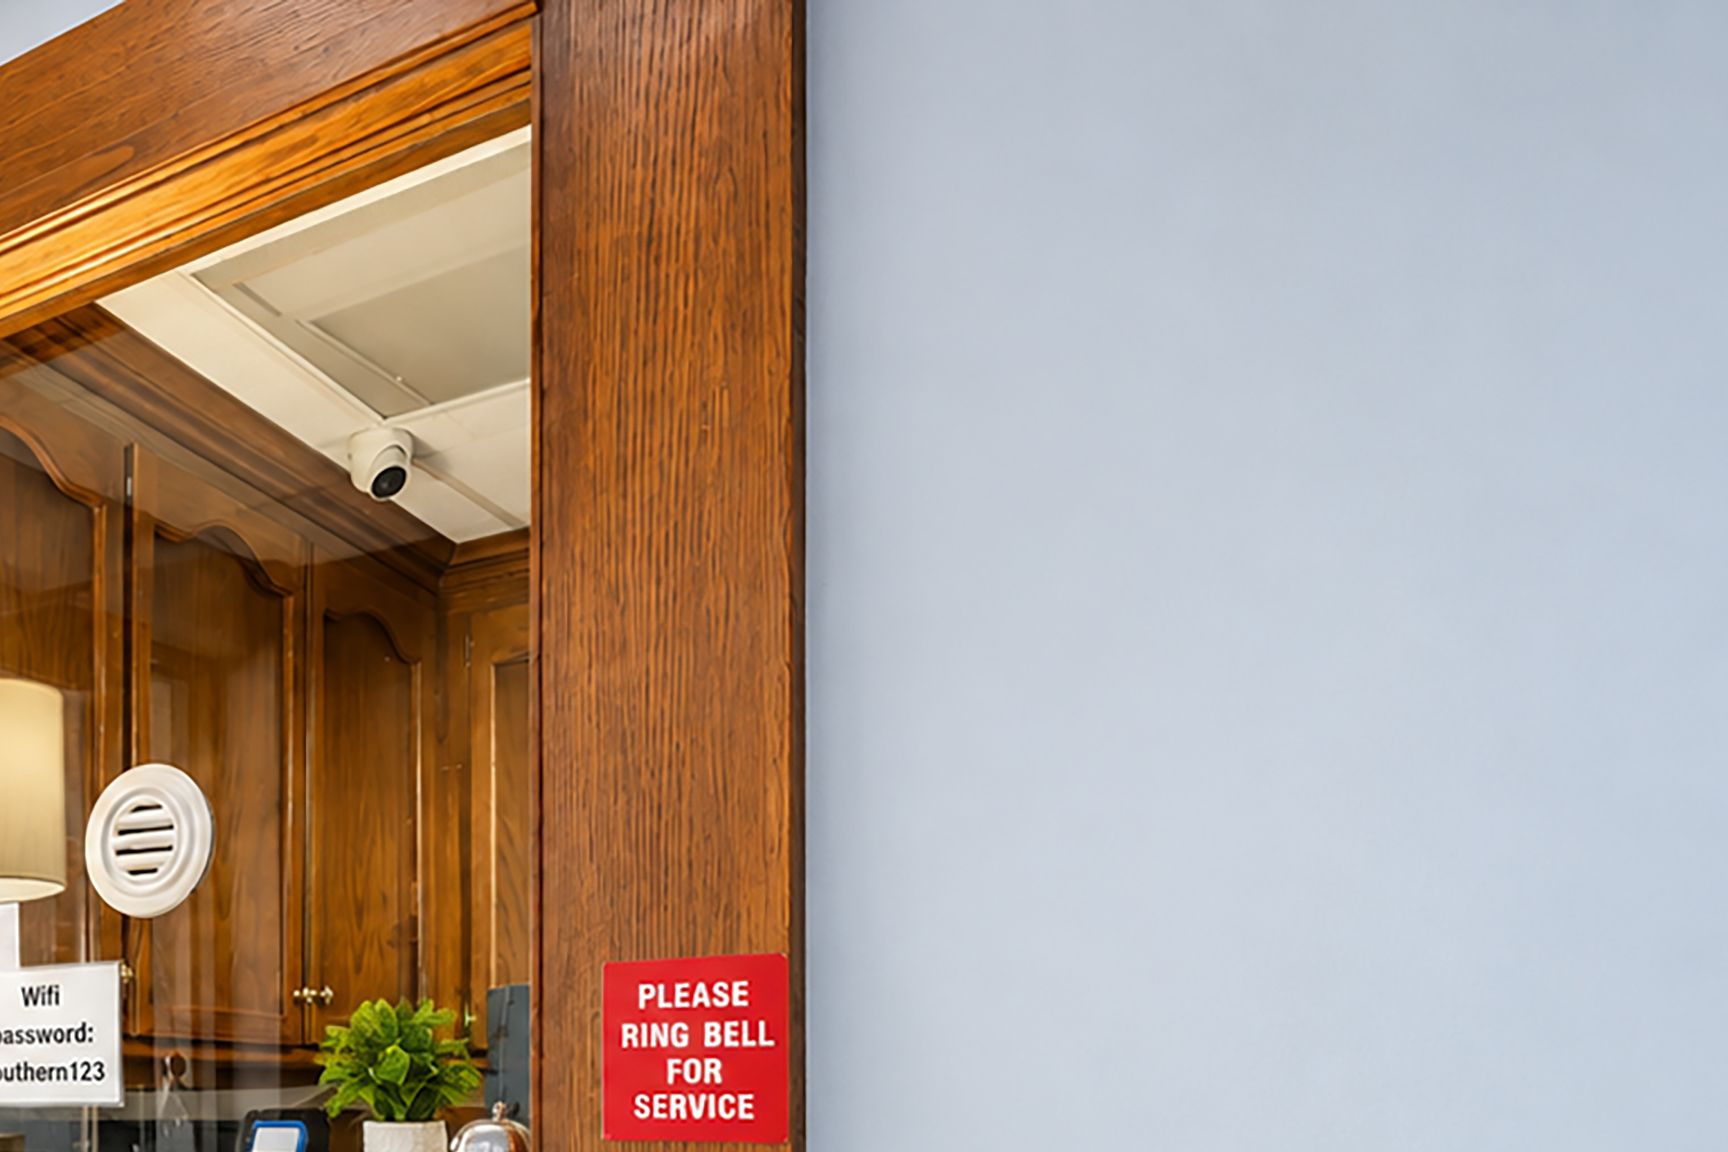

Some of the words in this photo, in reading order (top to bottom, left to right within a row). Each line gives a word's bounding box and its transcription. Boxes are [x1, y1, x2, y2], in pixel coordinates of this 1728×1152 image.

[21, 984, 60, 1007] Wifi
[638, 980, 749, 1010] PLEASE
[622, 1022, 689, 1049] RING
[703, 1020, 775, 1048] BELL
[667, 1057, 722, 1085] FOR
[634, 1093, 755, 1120] SERVICE
